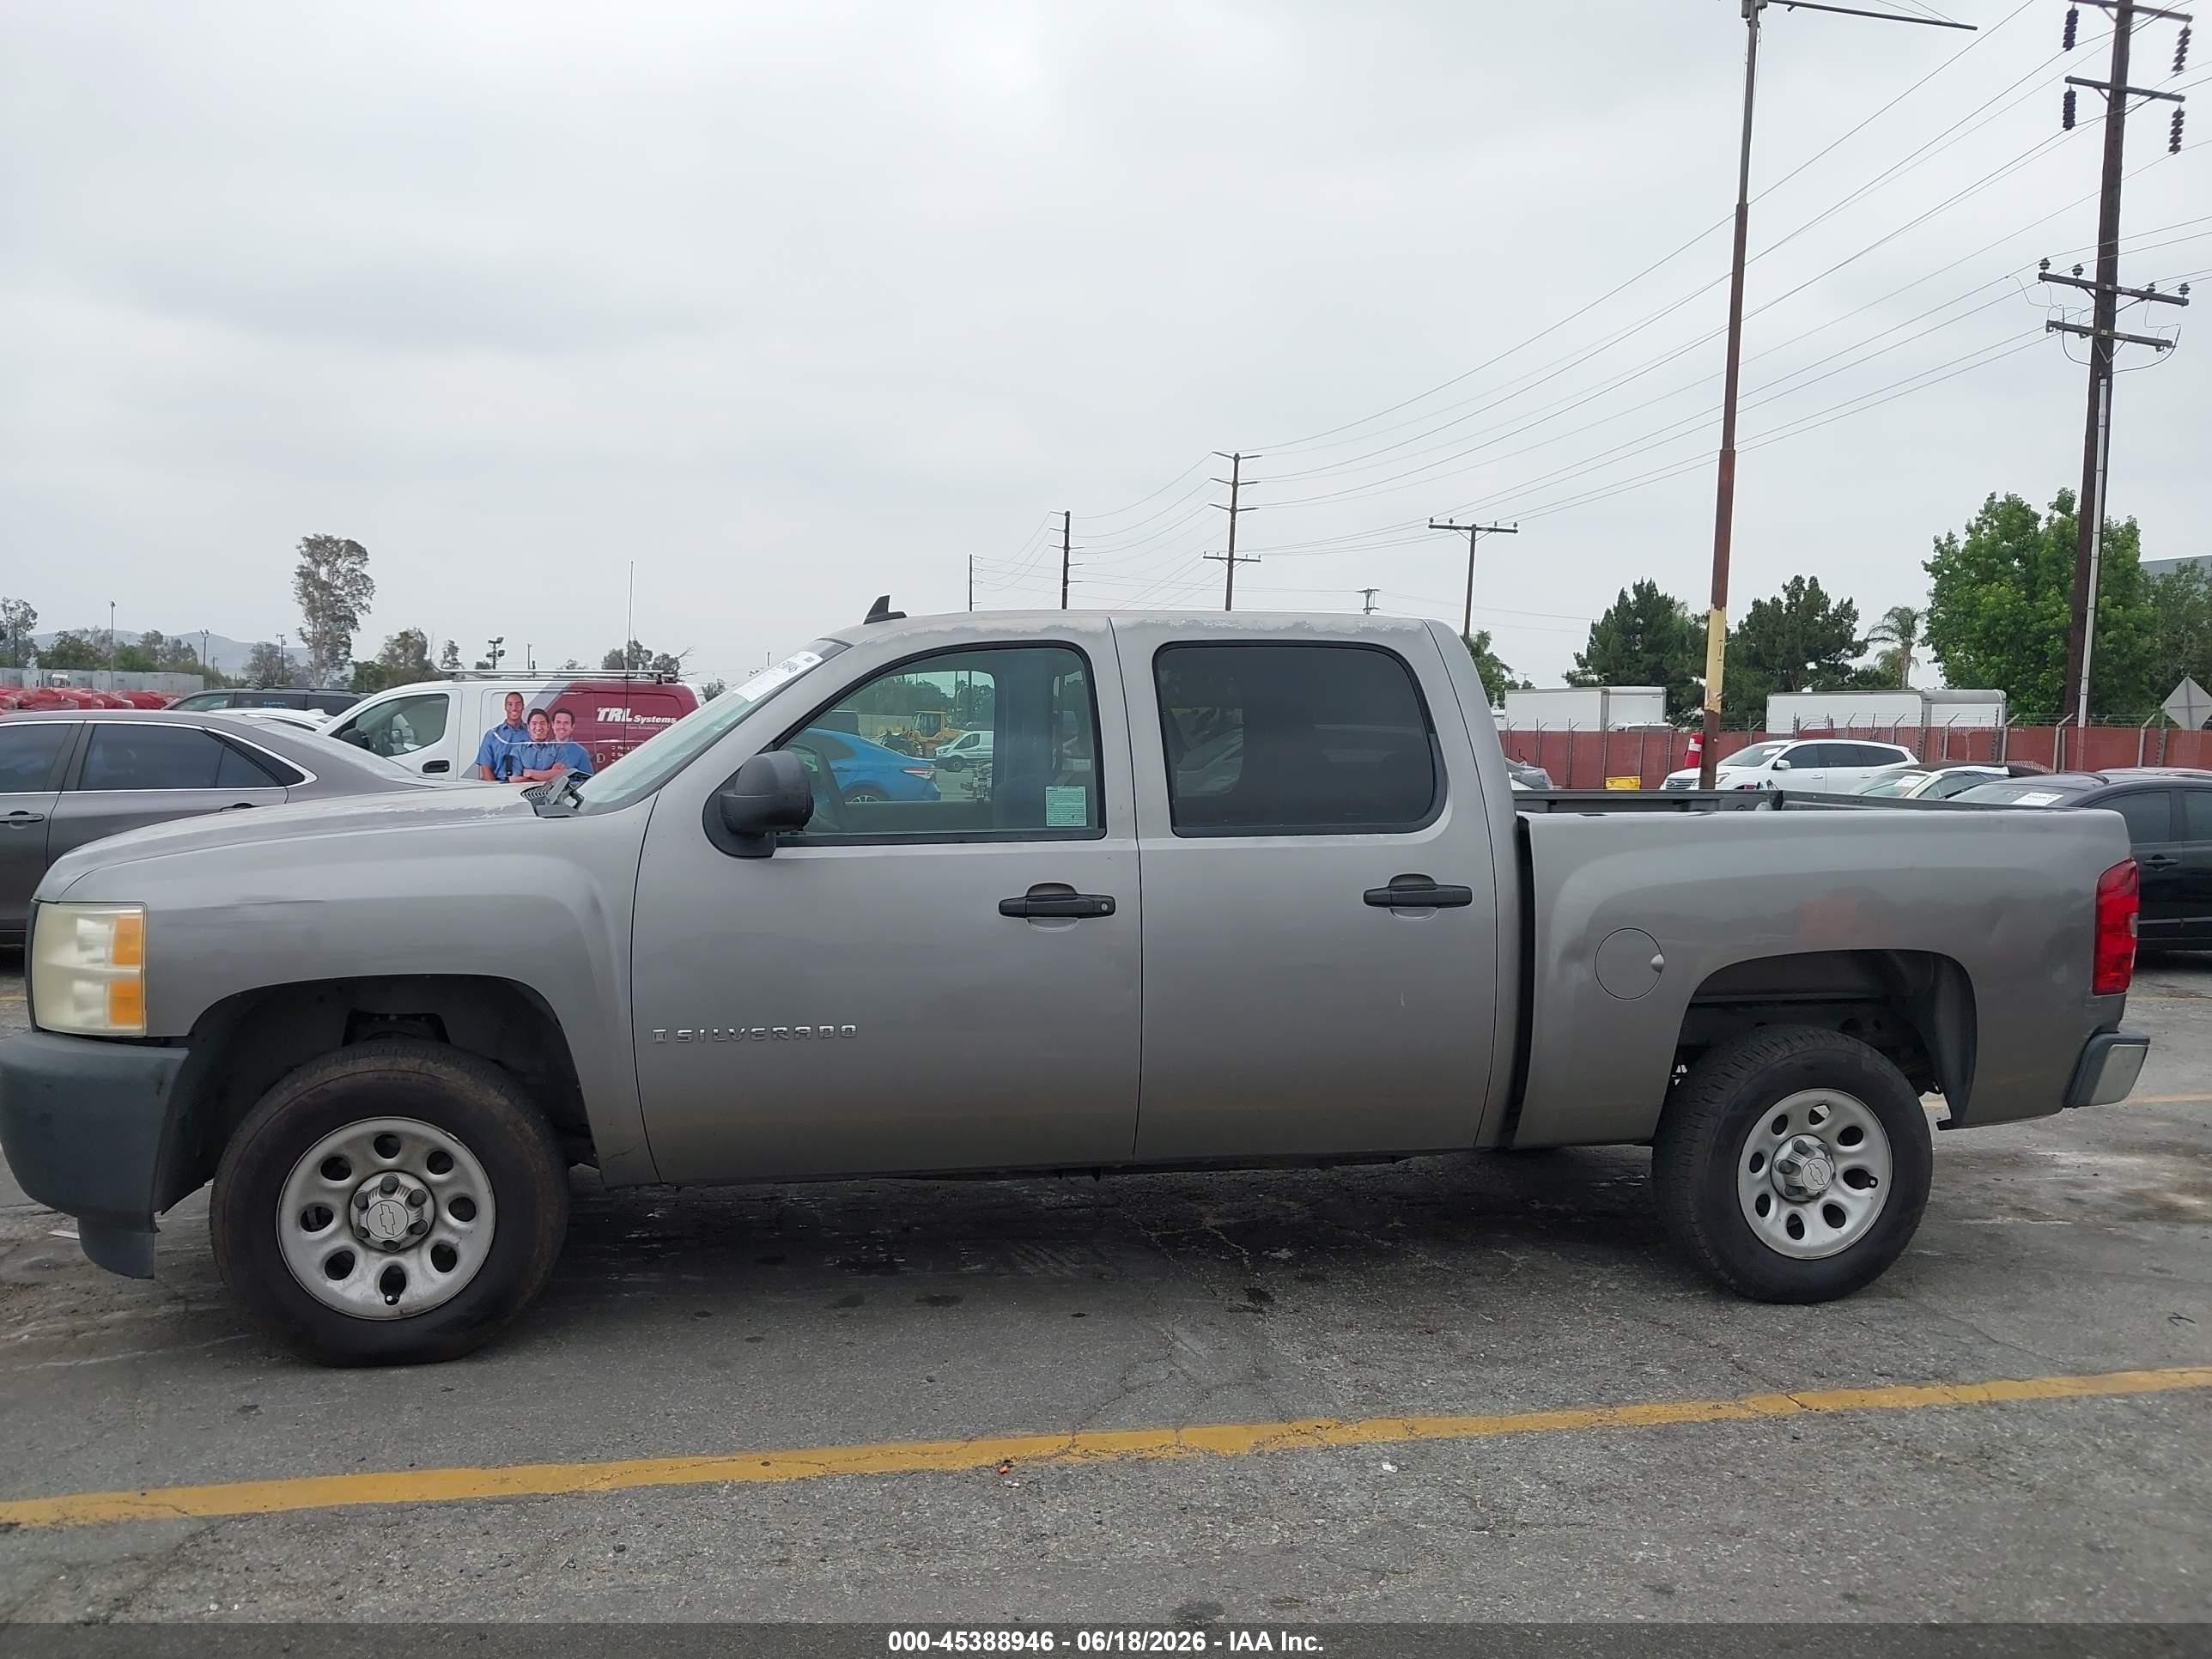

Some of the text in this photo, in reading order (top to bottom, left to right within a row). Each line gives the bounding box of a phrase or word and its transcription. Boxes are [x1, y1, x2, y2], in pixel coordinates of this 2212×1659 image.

[597, 707, 677, 724] TRL Systems
[676, 1024, 857, 1043] SILVERADO
